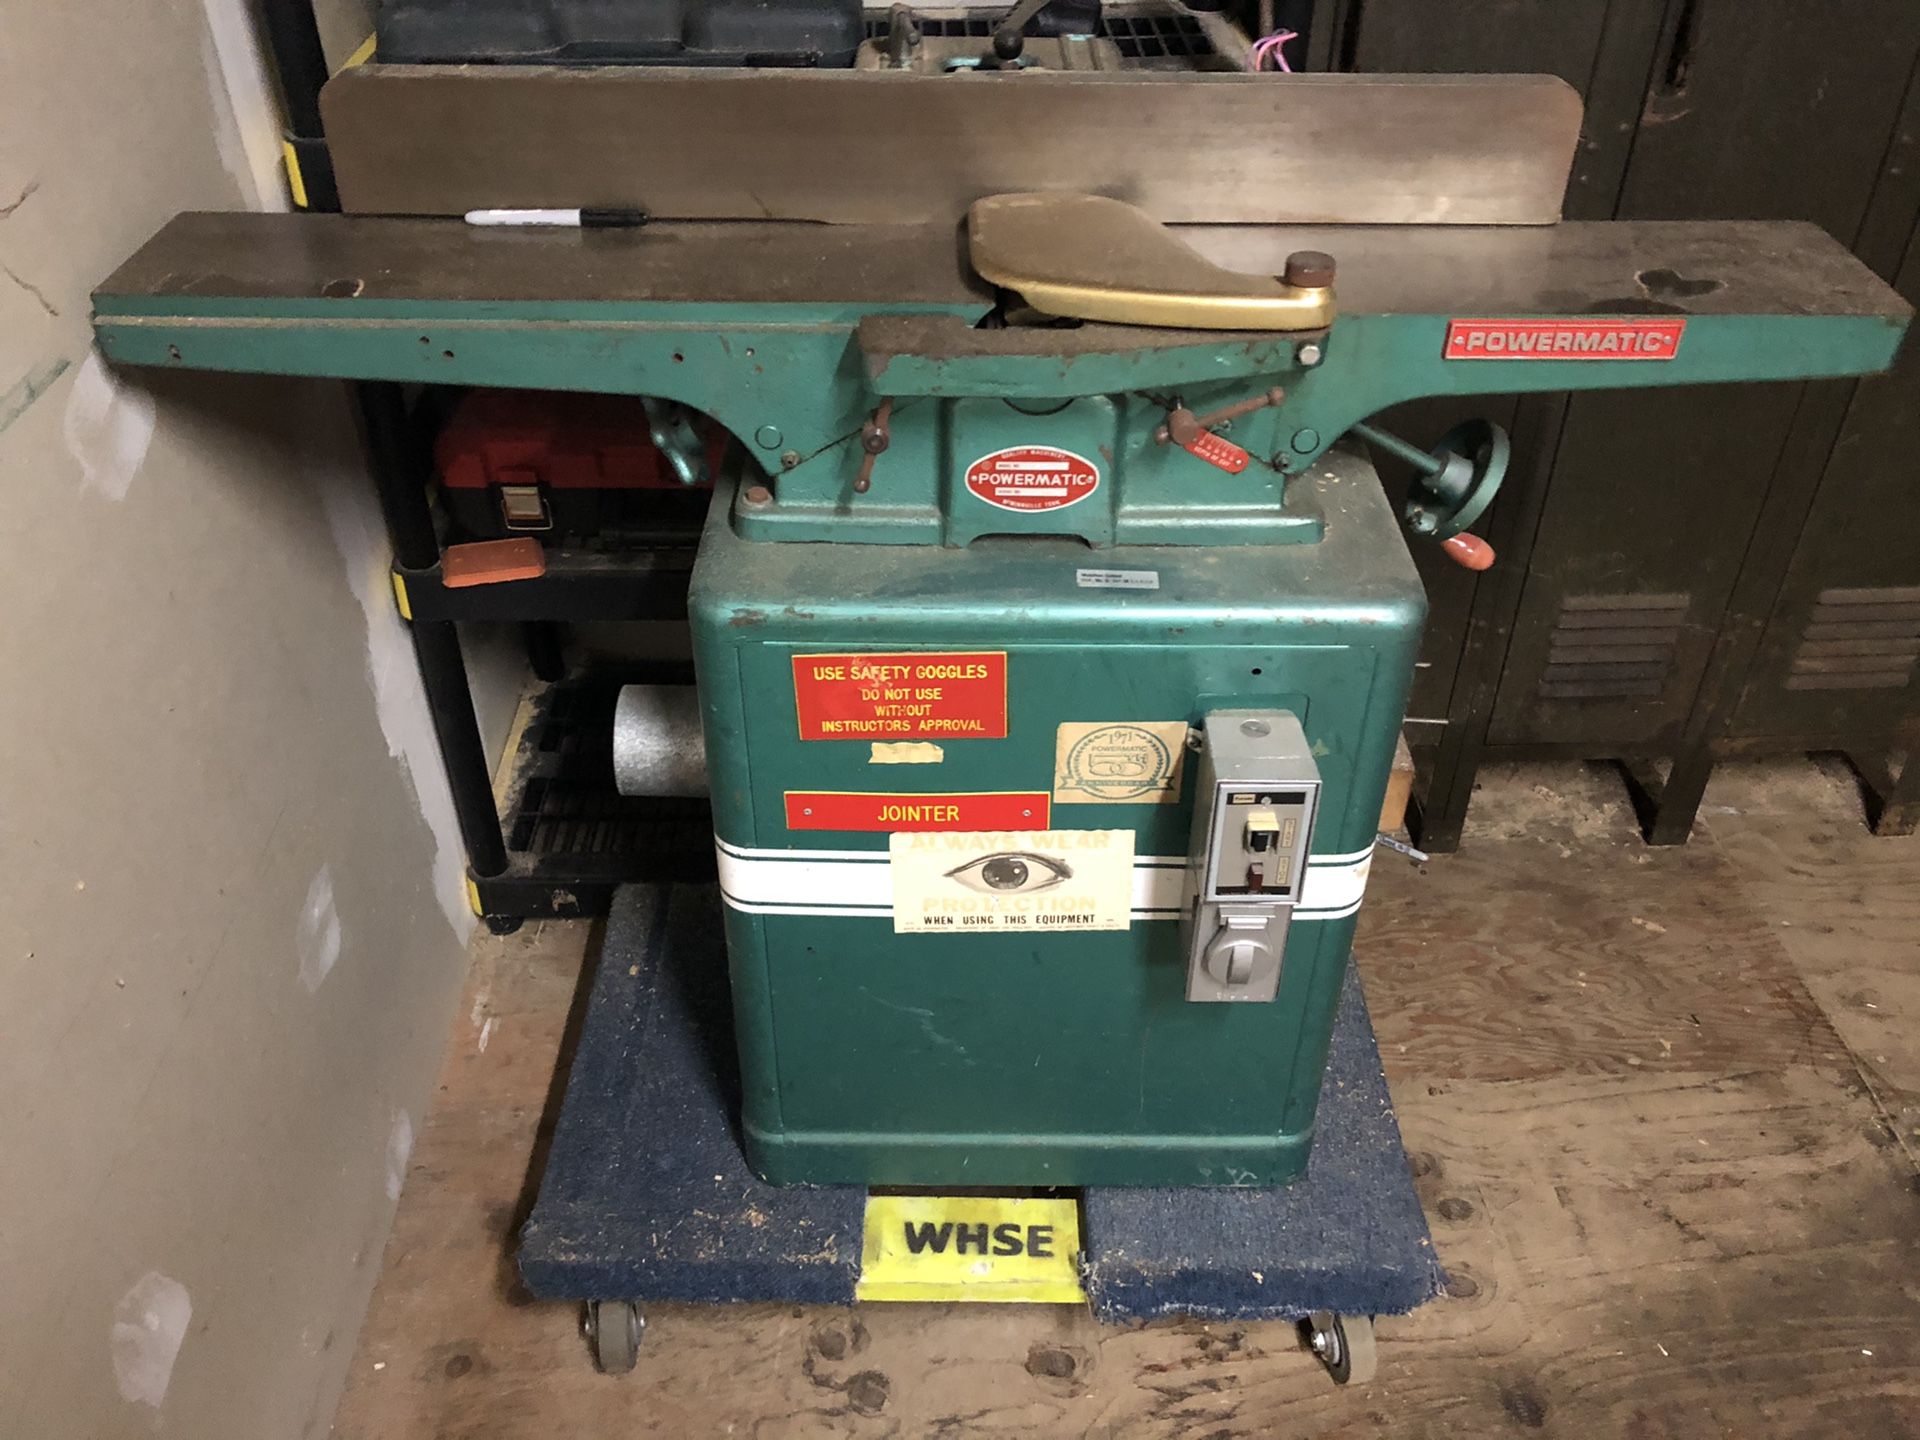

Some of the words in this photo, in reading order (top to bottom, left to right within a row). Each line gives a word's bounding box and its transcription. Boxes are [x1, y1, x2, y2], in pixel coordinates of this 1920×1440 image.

[1466, 331, 1664, 352] POWERMATIC
[978, 473, 1087, 486] POWERMATIC
[813, 666, 845, 681] USE
[850, 665, 911, 681] SAFETY
[916, 664, 988, 680] GOGGLES
[862, 688, 880, 701] DO
[884, 688, 911, 700] NOT
[915, 687, 943, 700] USE
[874, 704, 932, 717] WITHOUT
[821, 719, 911, 733] INSTRUCTORS
[918, 719, 985, 732] APPROVAL
[877, 805, 960, 822] JOINTER
[911, 833, 1018, 851] ALWAYS
[1024, 832, 1111, 850] WEAR
[922, 896, 1096, 913] PROTECTION
[923, 915, 954, 926] WHEN
[962, 915, 995, 926] USING
[1004, 914, 1027, 925] THIS
[1036, 913, 1096, 925] EQUIPMENT
[904, 1221, 1055, 1258] WHSE
